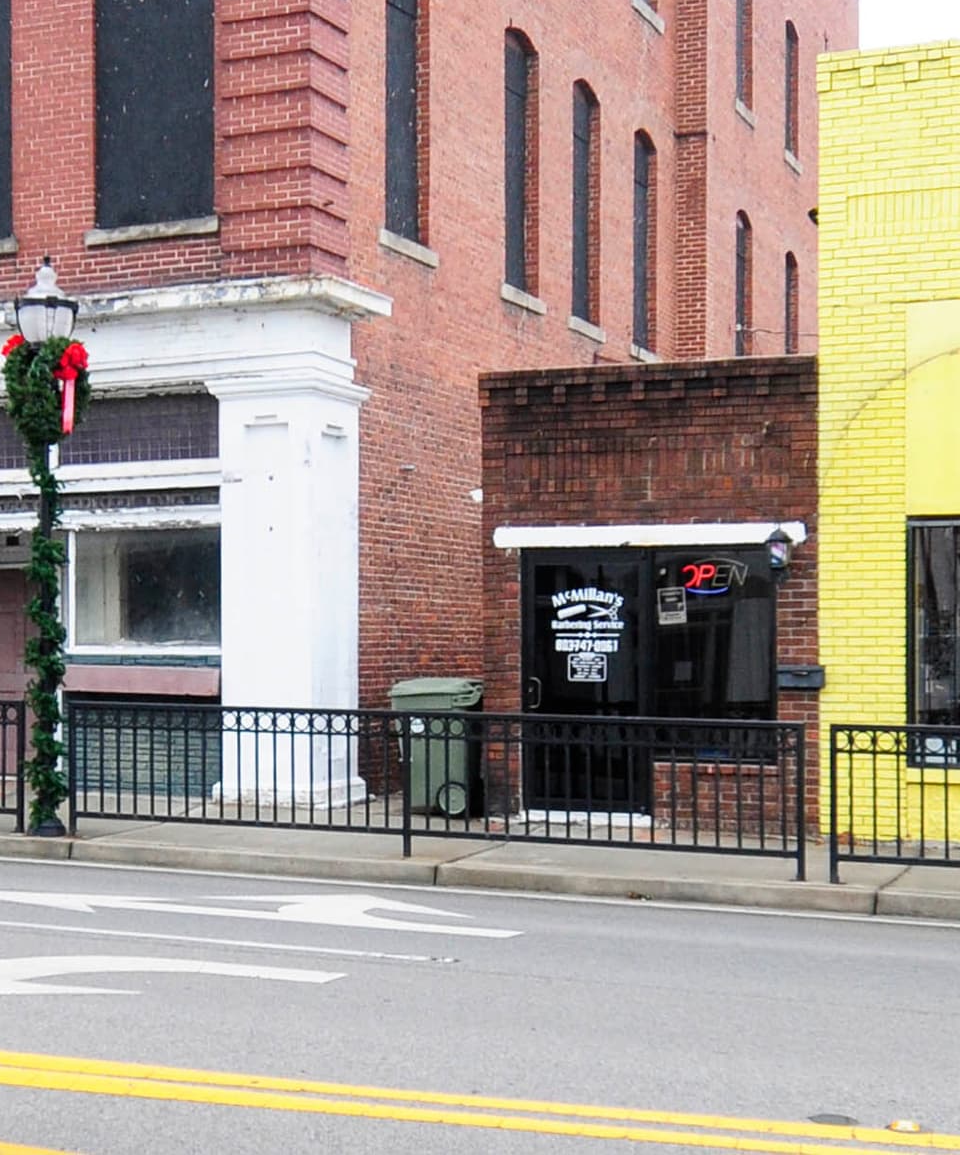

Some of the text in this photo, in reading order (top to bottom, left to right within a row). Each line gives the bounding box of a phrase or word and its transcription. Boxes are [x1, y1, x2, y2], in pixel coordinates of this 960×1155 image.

[682, 564, 749, 588] OPEN
[551, 587, 625, 608] McMillan's
[551, 619, 625, 631] Barbering Service
